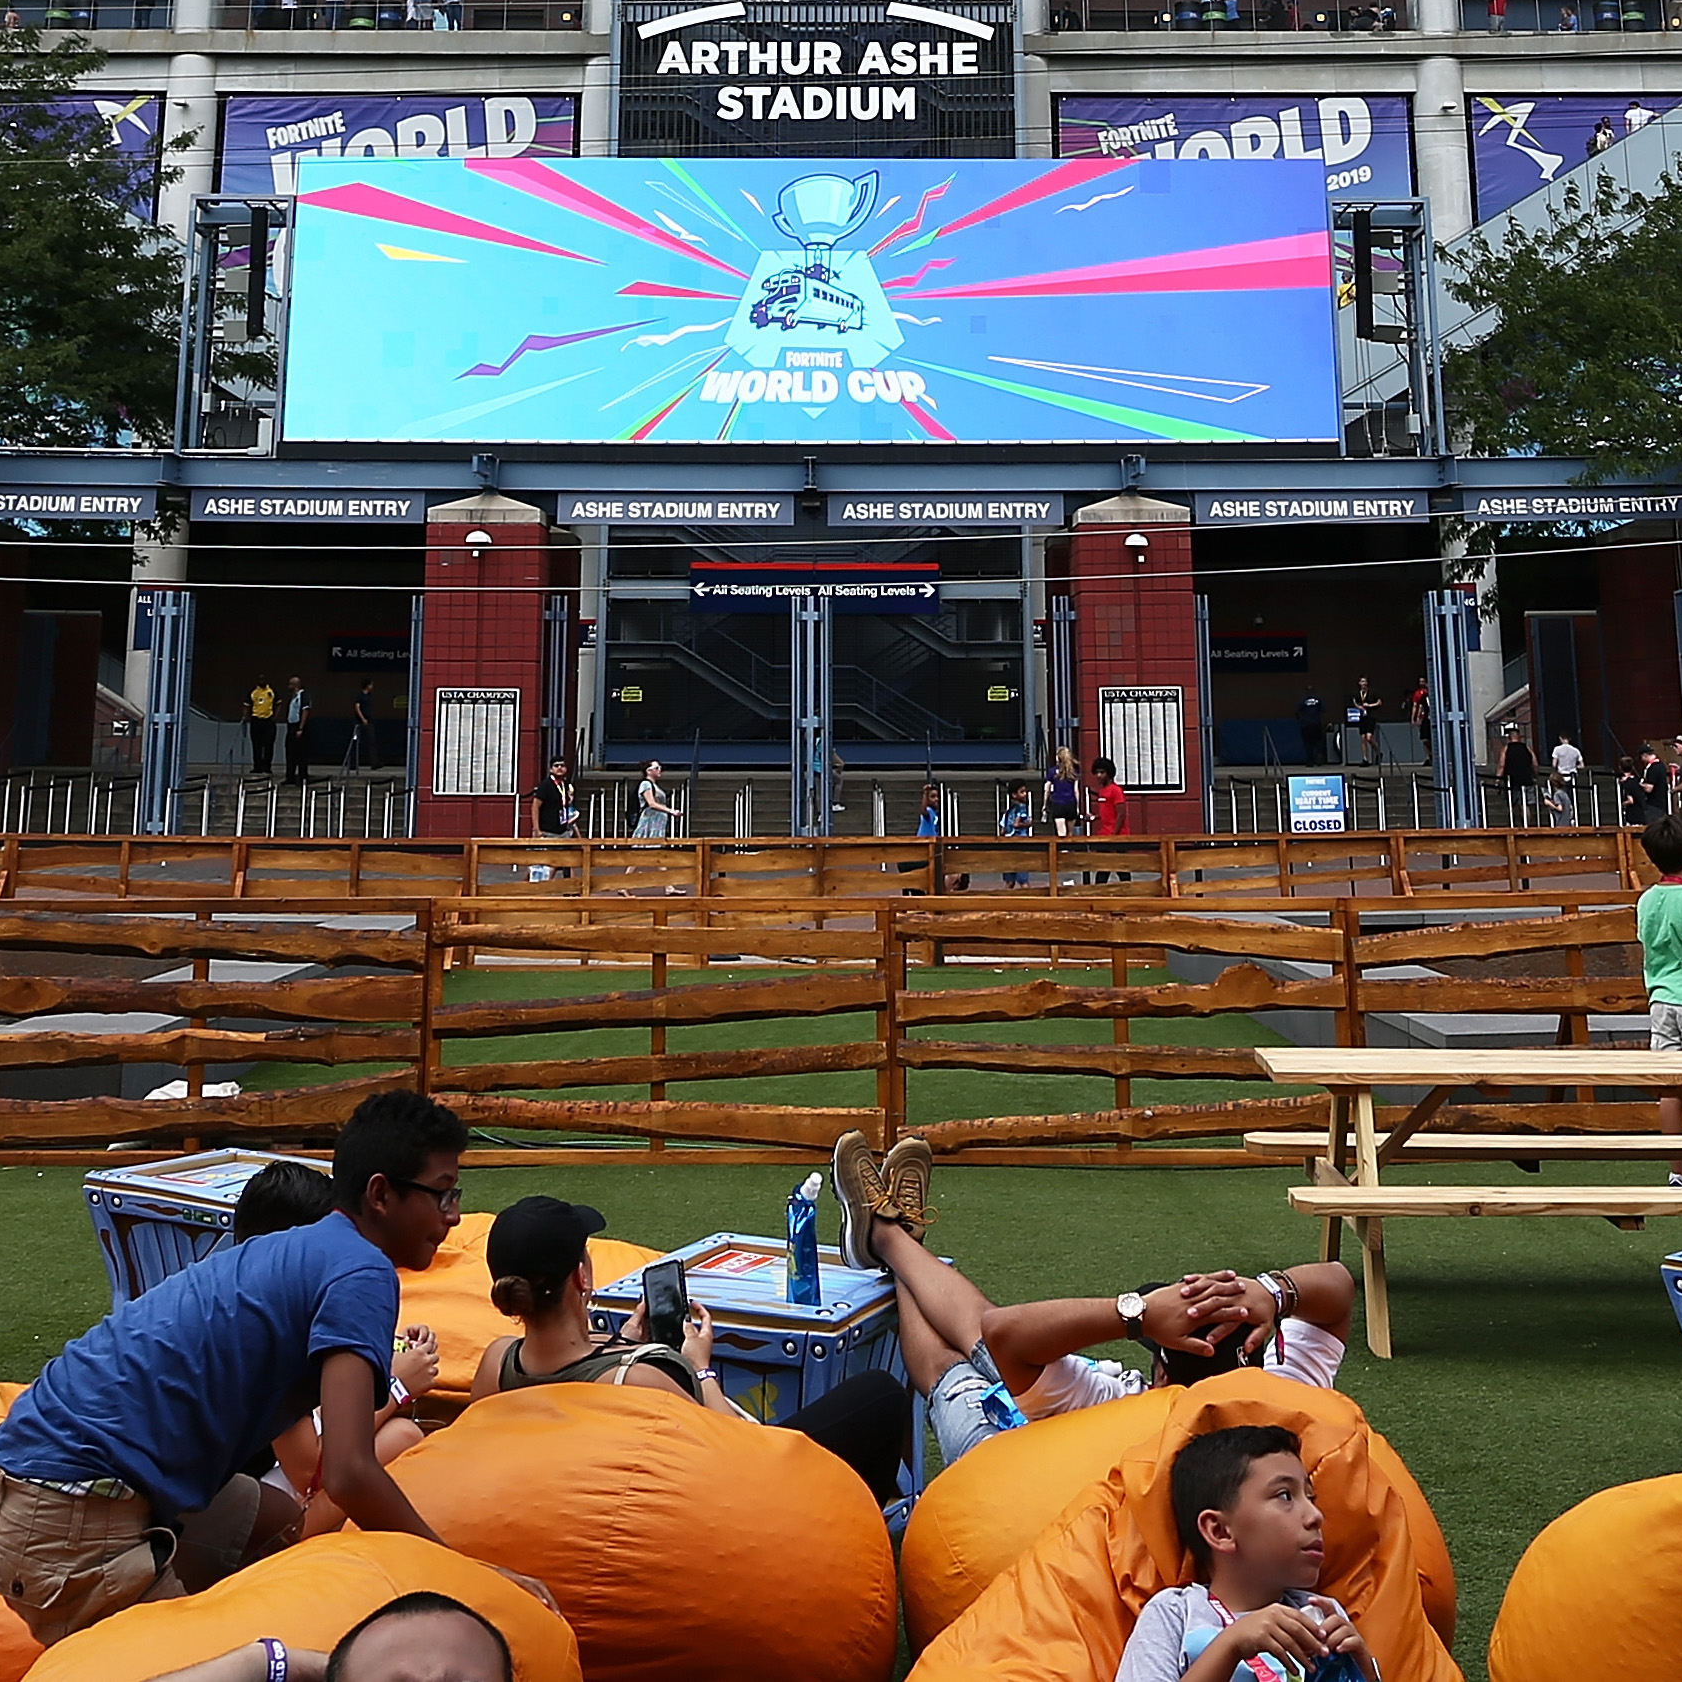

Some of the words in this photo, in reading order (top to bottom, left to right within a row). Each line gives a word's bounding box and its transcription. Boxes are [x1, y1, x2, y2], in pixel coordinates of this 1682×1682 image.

[656, 41, 842, 75] ARTHUR
[857, 41, 979, 75] ASHE
[716, 86, 916, 120] STADIUM
[265, 110, 346, 150] FORTNITE
[1096, 112, 1179, 155] FORTNITE
[1326, 165, 1373, 193] 2019
[785, 351, 843, 368] FORTNITE
[699, 370, 839, 404] WORLD
[846, 370, 927, 404] CUP
[79, 496, 142, 513] ENTRY
[204, 499, 255, 515] ASHE
[259, 499, 343, 516] STADIUM
[348, 500, 411, 516] ENTRY
[571, 502, 623, 518] ASHE
[628, 502, 712, 518] STADIUM
[718, 502, 781, 519] ENTRY
[843, 503, 894, 519] ASHE
[899, 503, 983, 519] STADIUM
[987, 502, 1050, 519] ENTRY
[1209, 501, 1261, 517] ASHE
[1265, 500, 1348, 517] STADIUM
[1353, 500, 1415, 516] ENTRY
[1477, 498, 1527, 515] ASHE
[1532, 498, 1615, 514] STADIUM
[1619, 497, 1680, 513] ENTRY
[713, 585, 728, 595] All
[730, 585, 773, 598] Seating
[775, 585, 811, 596] Levels
[818, 585, 832, 597] All
[835, 586, 878, 599] Seating
[880, 585, 917, 597] Levels
[1317, 795, 1339, 805] TIME
[1293, 819, 1342, 831] CLOSED
